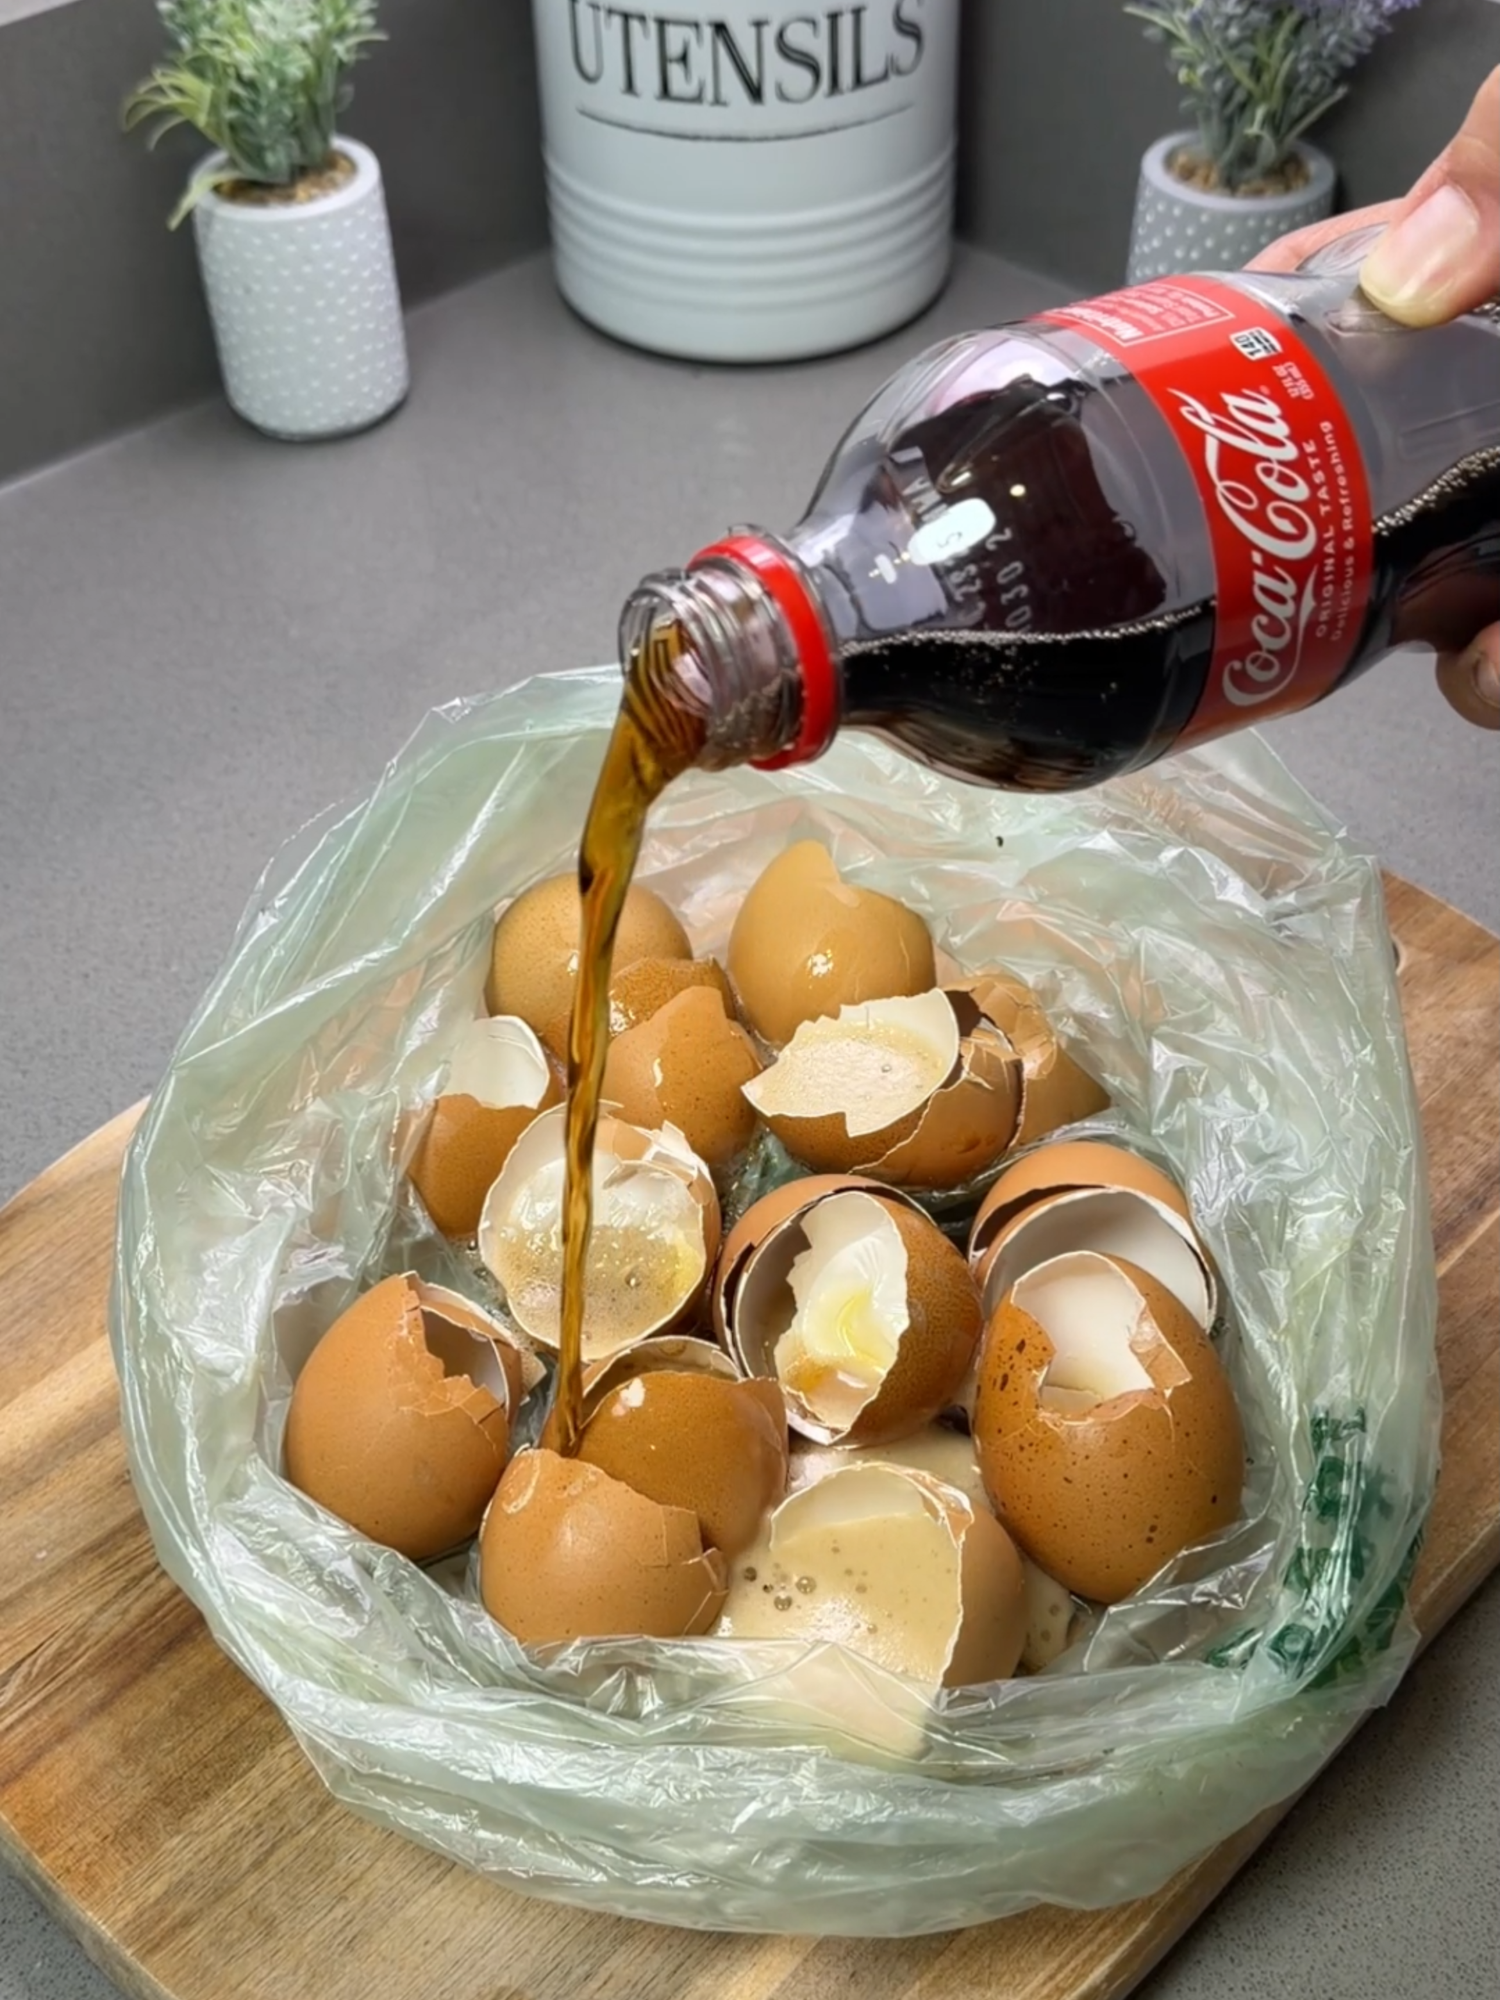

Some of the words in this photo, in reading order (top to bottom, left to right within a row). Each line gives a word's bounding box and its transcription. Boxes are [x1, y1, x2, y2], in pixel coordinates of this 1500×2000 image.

[568, 0, 926, 107] UTENSILS
[1234, 335, 1263, 357] 140
[1302, 438, 1332, 518] TASTE
[1319, 420, 1354, 531] Refreshing
[1167, 386, 1318, 707] Coca-Cola
[1315, 524, 1336, 648] ORIGINAL
[1343, 537, 1355, 550] &
[1330, 556, 1355, 642] Delicious
